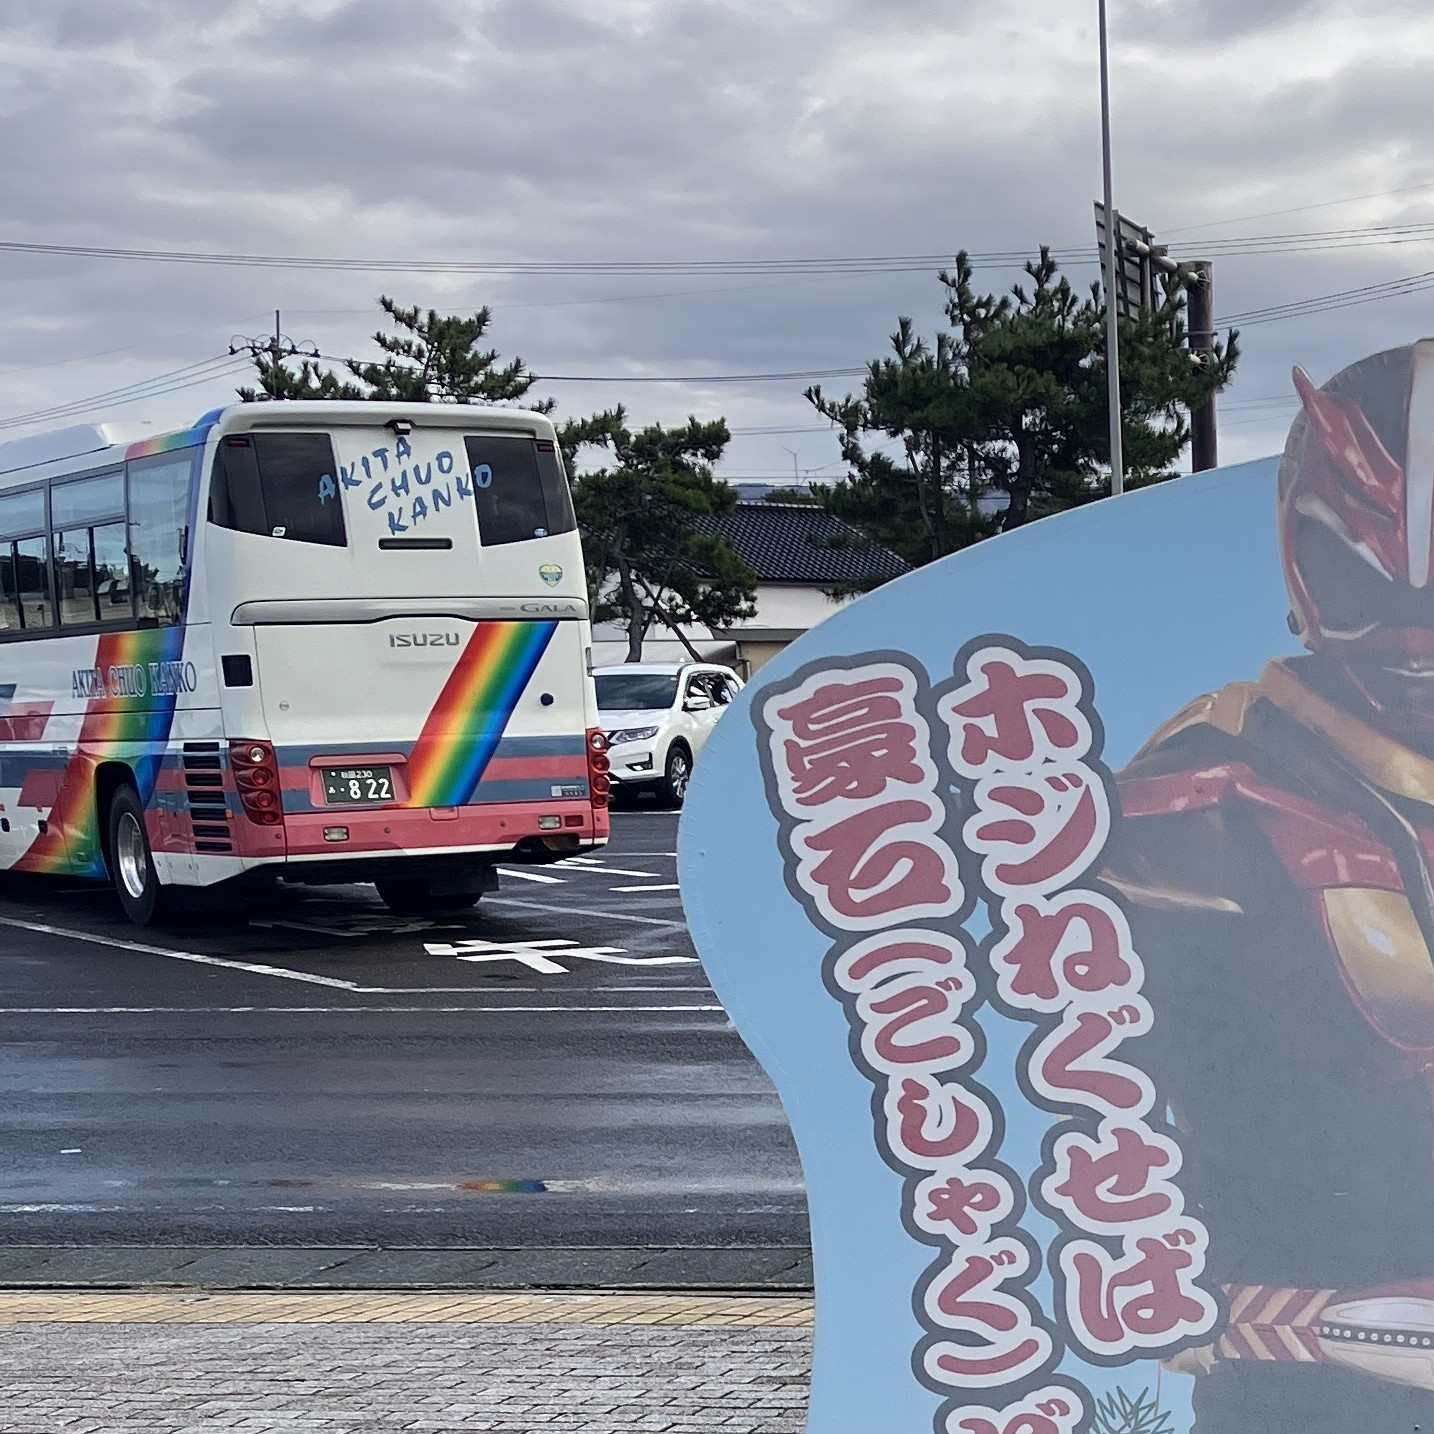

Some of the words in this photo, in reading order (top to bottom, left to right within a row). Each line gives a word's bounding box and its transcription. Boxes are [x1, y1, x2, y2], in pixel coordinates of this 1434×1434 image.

[318, 436, 412, 505] AKITA
[367, 451, 454, 511] CHUO
[387, 464, 493, 536] KANKO
[519, 603, 577, 613] GALA
[389, 632, 460, 648] ISUZU
[72, 667, 106, 698] AKITA
[108, 664, 147, 697] CHUO
[148, 661, 198, 697] KANKO
[939, 646, 1217, 1355] ホジねぐせば
